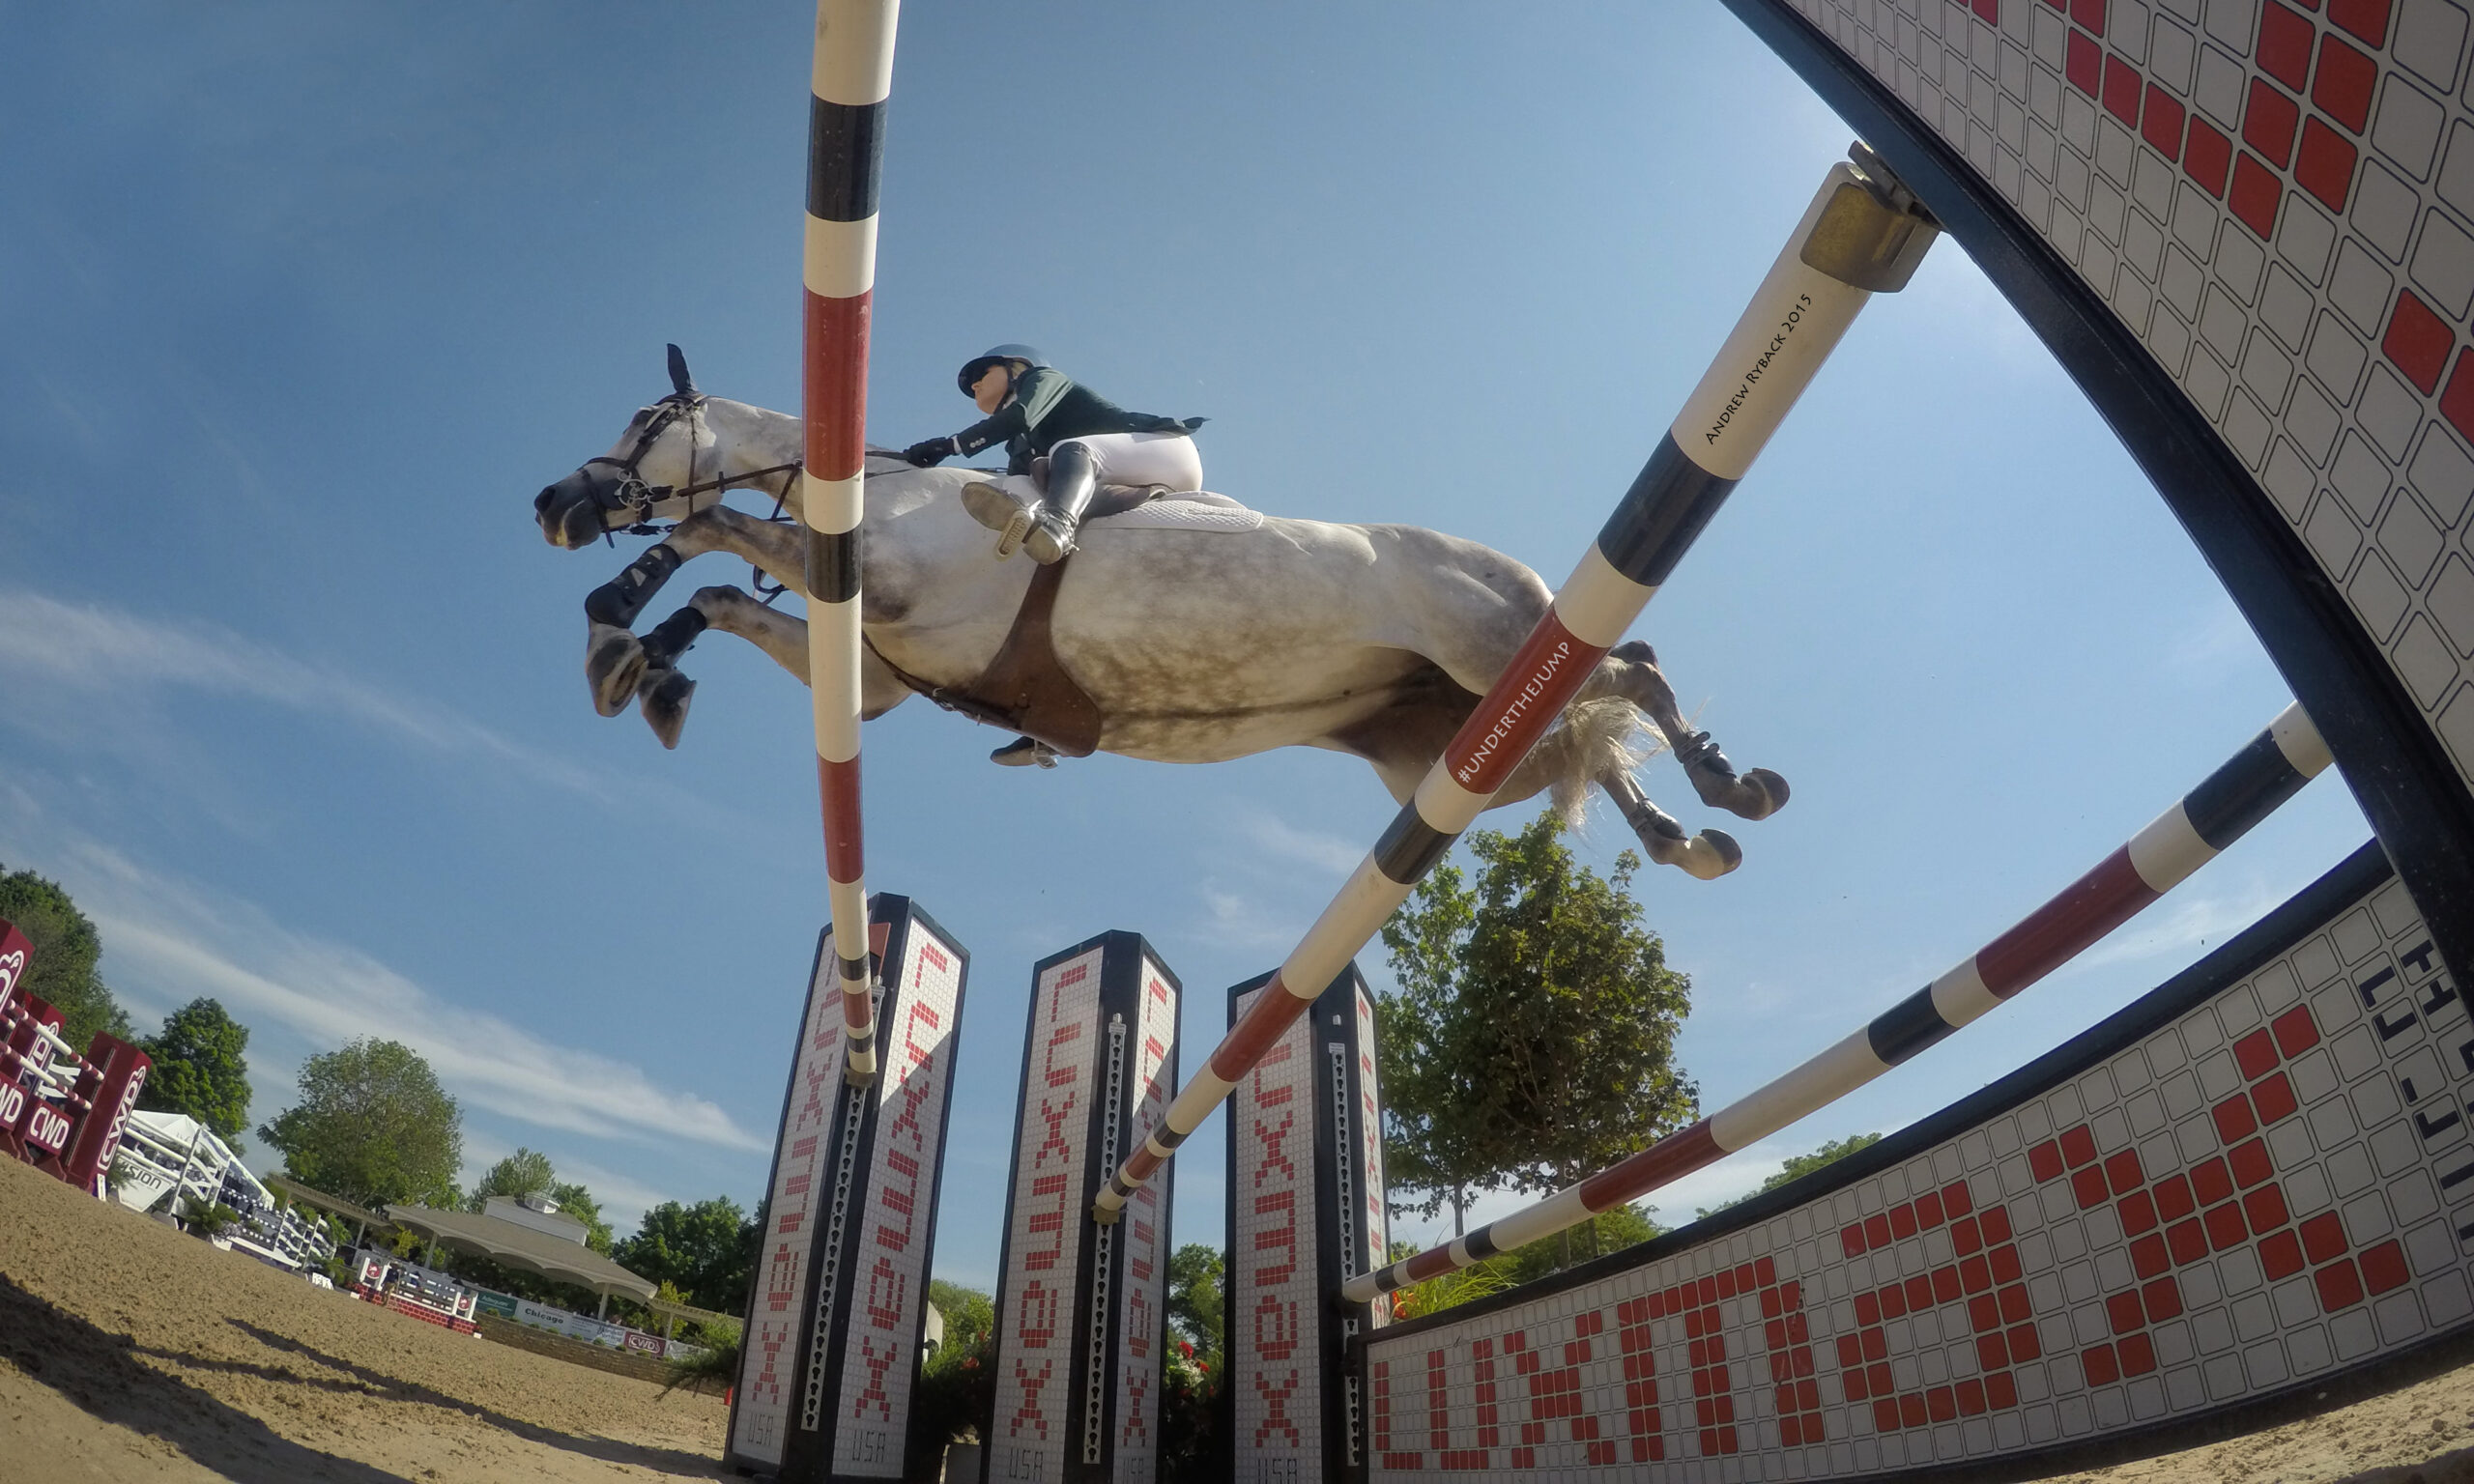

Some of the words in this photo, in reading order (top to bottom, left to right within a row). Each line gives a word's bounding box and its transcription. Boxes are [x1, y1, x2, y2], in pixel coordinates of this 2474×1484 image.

[1705, 384, 1749, 445] ANDREW
[1745, 333, 1786, 385] RYBACK
[1781, 293, 1811, 332] 2015
[1457, 642, 1570, 784] #UNDERTHEJUMP
[30, 1106, 71, 1150] CWD
[101, 1079, 139, 1166] CWD
[525, 1307, 564, 1324] Chicago
[630, 1337, 656, 1352] CWD
[747, 1412, 774, 1447] USA
[851, 1429, 886, 1464] USA
[1008, 1447, 1044, 1482] USA
[1257, 1458, 1298, 1482] USA
